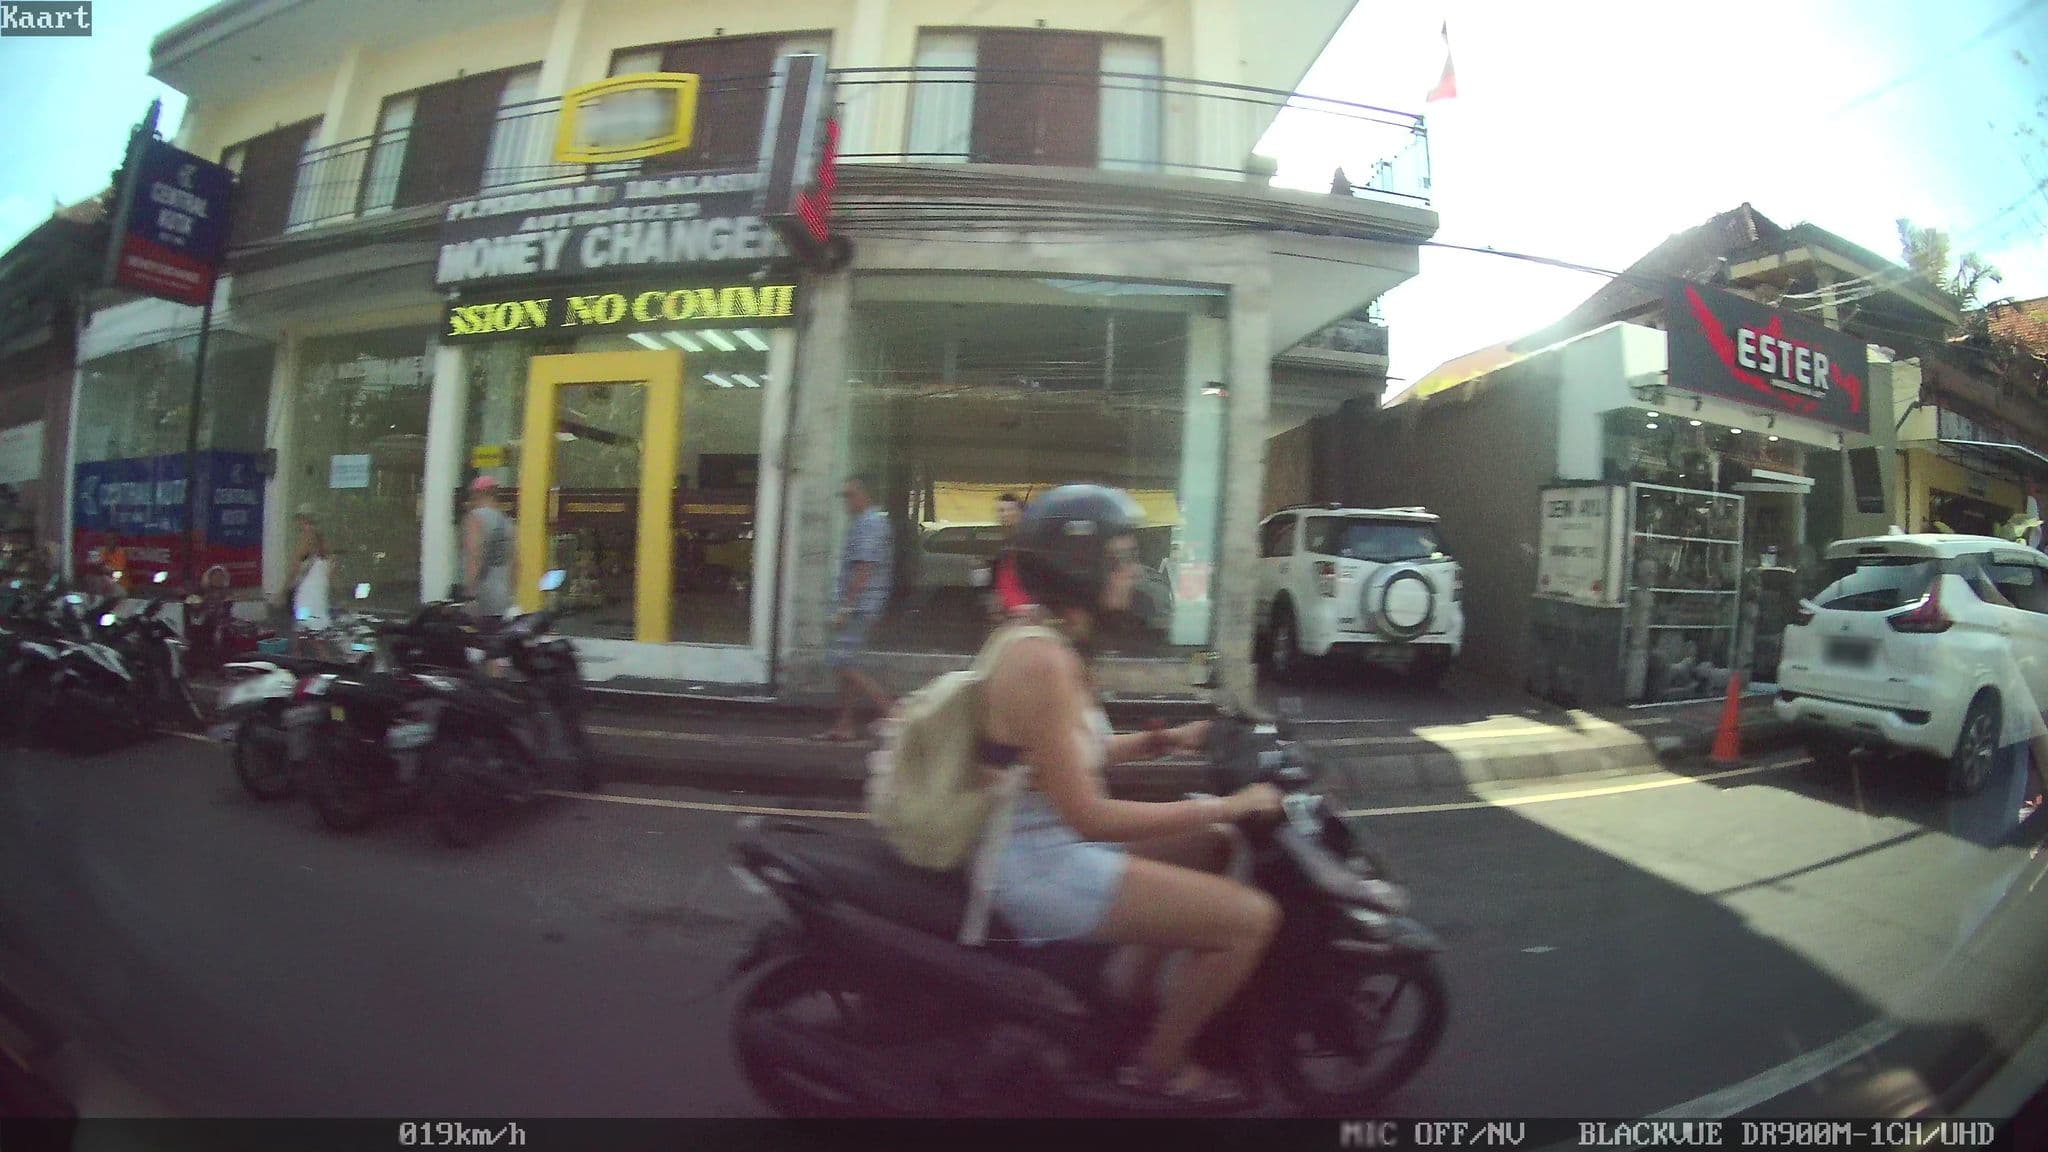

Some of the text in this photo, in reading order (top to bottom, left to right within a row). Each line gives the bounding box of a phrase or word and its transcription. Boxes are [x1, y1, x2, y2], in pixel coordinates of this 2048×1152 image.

[436, 228, 571, 284] MONEY
[561, 294, 627, 328] NO
[1737, 327, 1830, 391] ESTER
